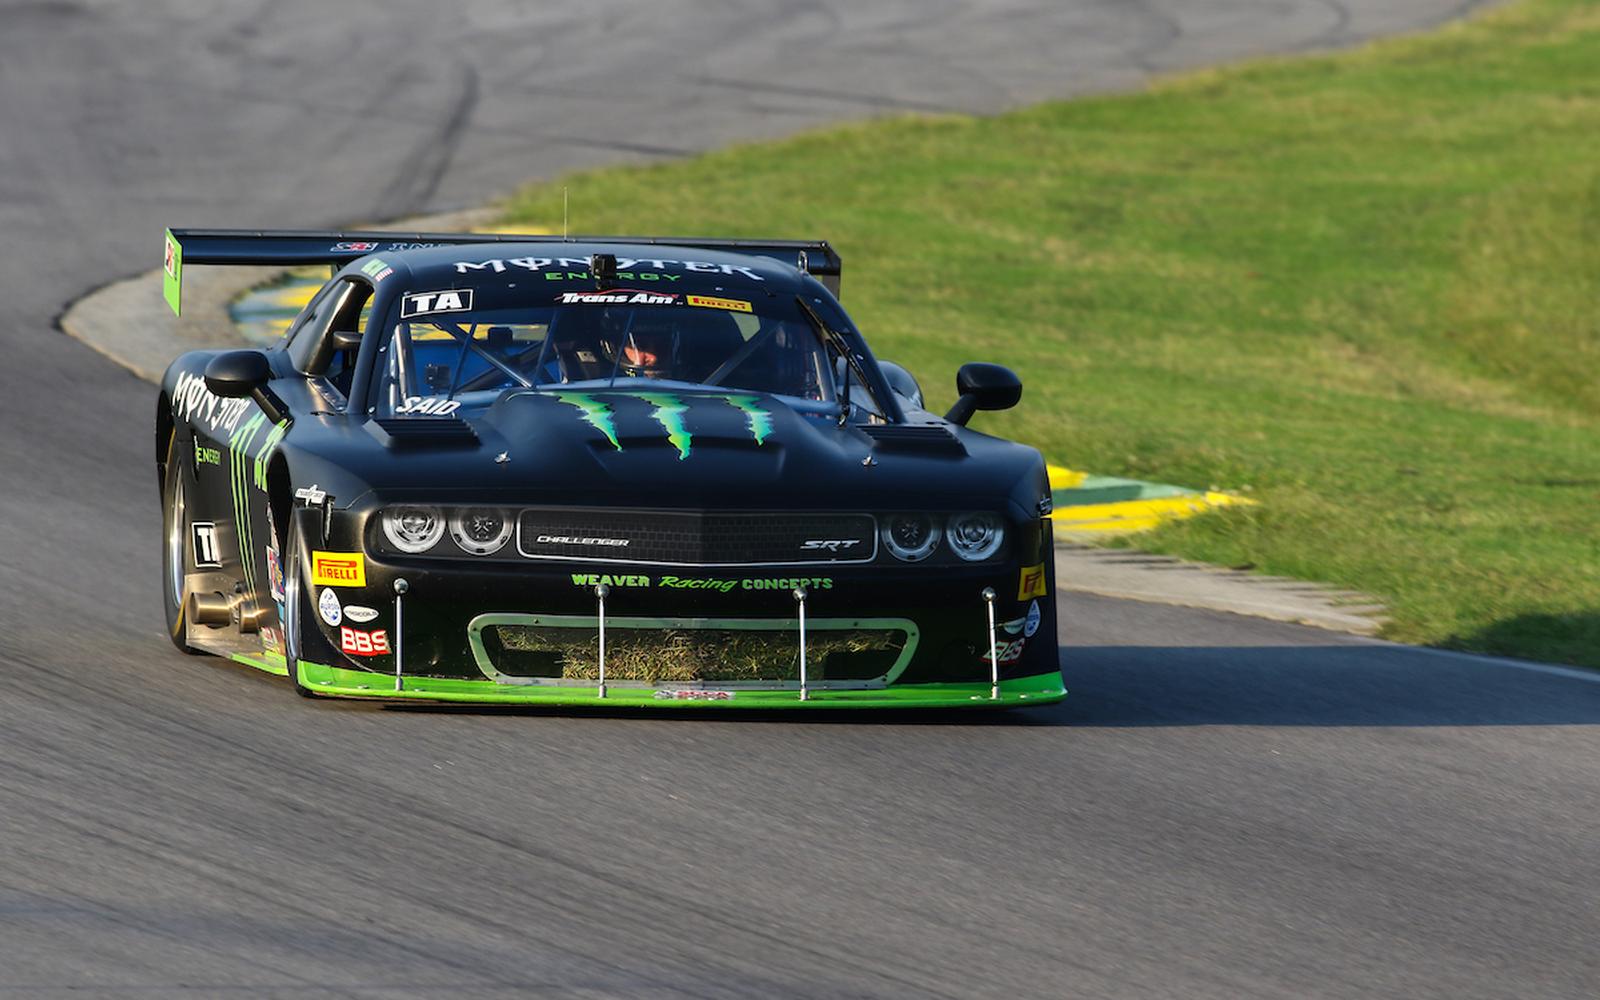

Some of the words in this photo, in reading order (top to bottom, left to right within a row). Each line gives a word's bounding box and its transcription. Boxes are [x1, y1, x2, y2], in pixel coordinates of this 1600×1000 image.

[545, 271, 681, 281] ENRGY
[411, 292, 462, 312] TA
[561, 292, 628, 303] Trans
[629, 292, 674, 304] Am
[395, 396, 461, 415] SAID
[536, 535, 630, 547] CHALLENGER
[800, 540, 861, 551] SRT
[317, 559, 358, 580] PIRELLI
[571, 574, 650, 587] WEAVER
[658, 575, 737, 593] Racing
[742, 578, 833, 590] CONCEPTS
[341, 626, 388, 654] BBS
